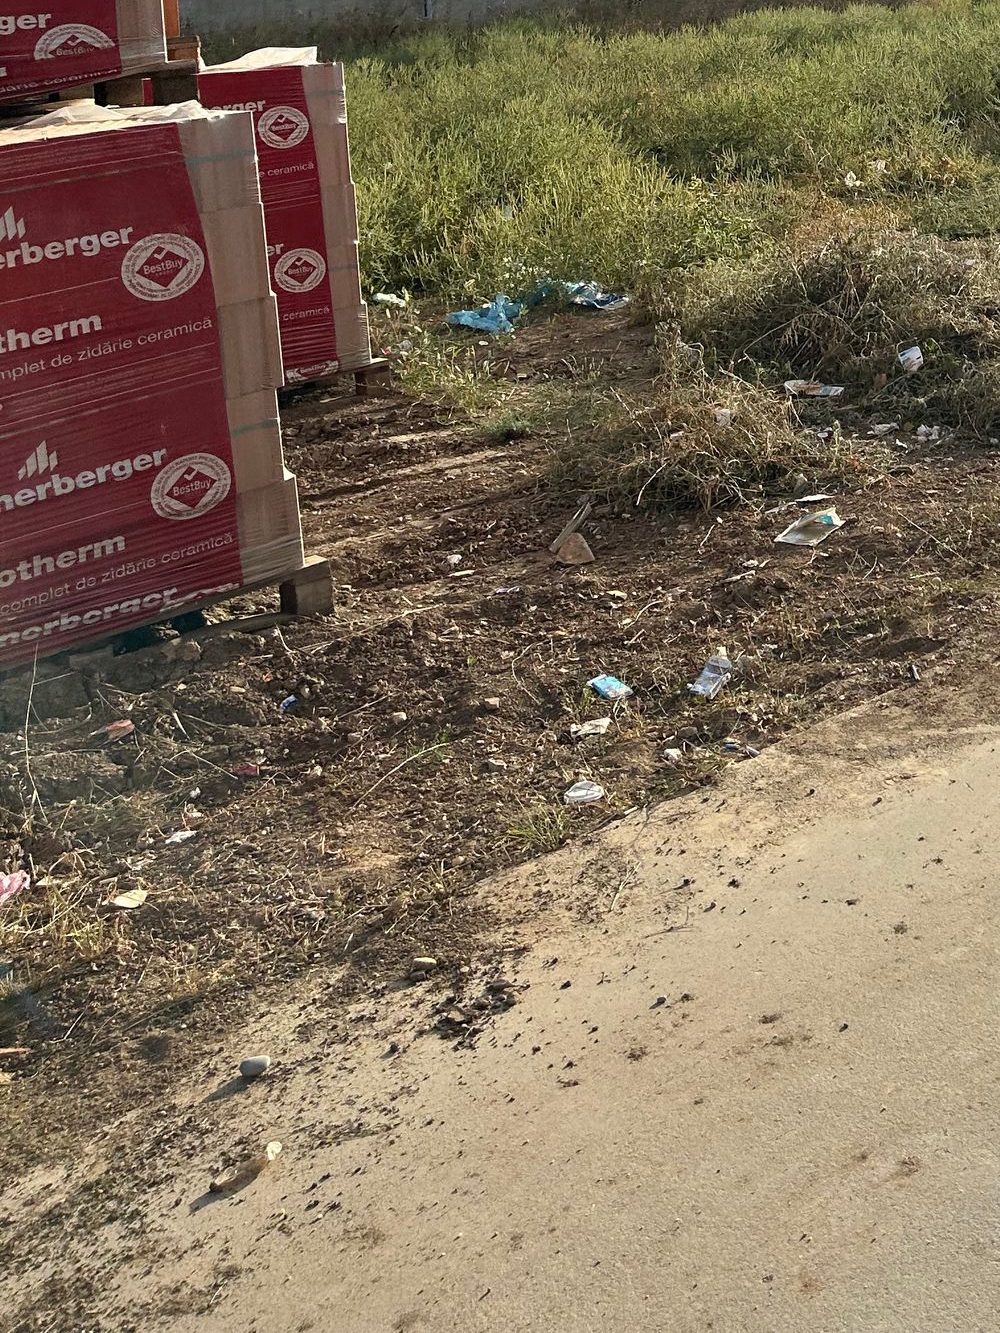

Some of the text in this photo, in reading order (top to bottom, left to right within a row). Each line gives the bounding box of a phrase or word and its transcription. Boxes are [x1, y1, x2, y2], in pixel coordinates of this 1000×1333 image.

[143, 259, 183, 275] BestBuy
[51, 352, 73, 368] de
[78, 338, 134, 362] zidărie
[137, 317, 213, 346] ceramică
[173, 478, 212, 497] BestBuy
